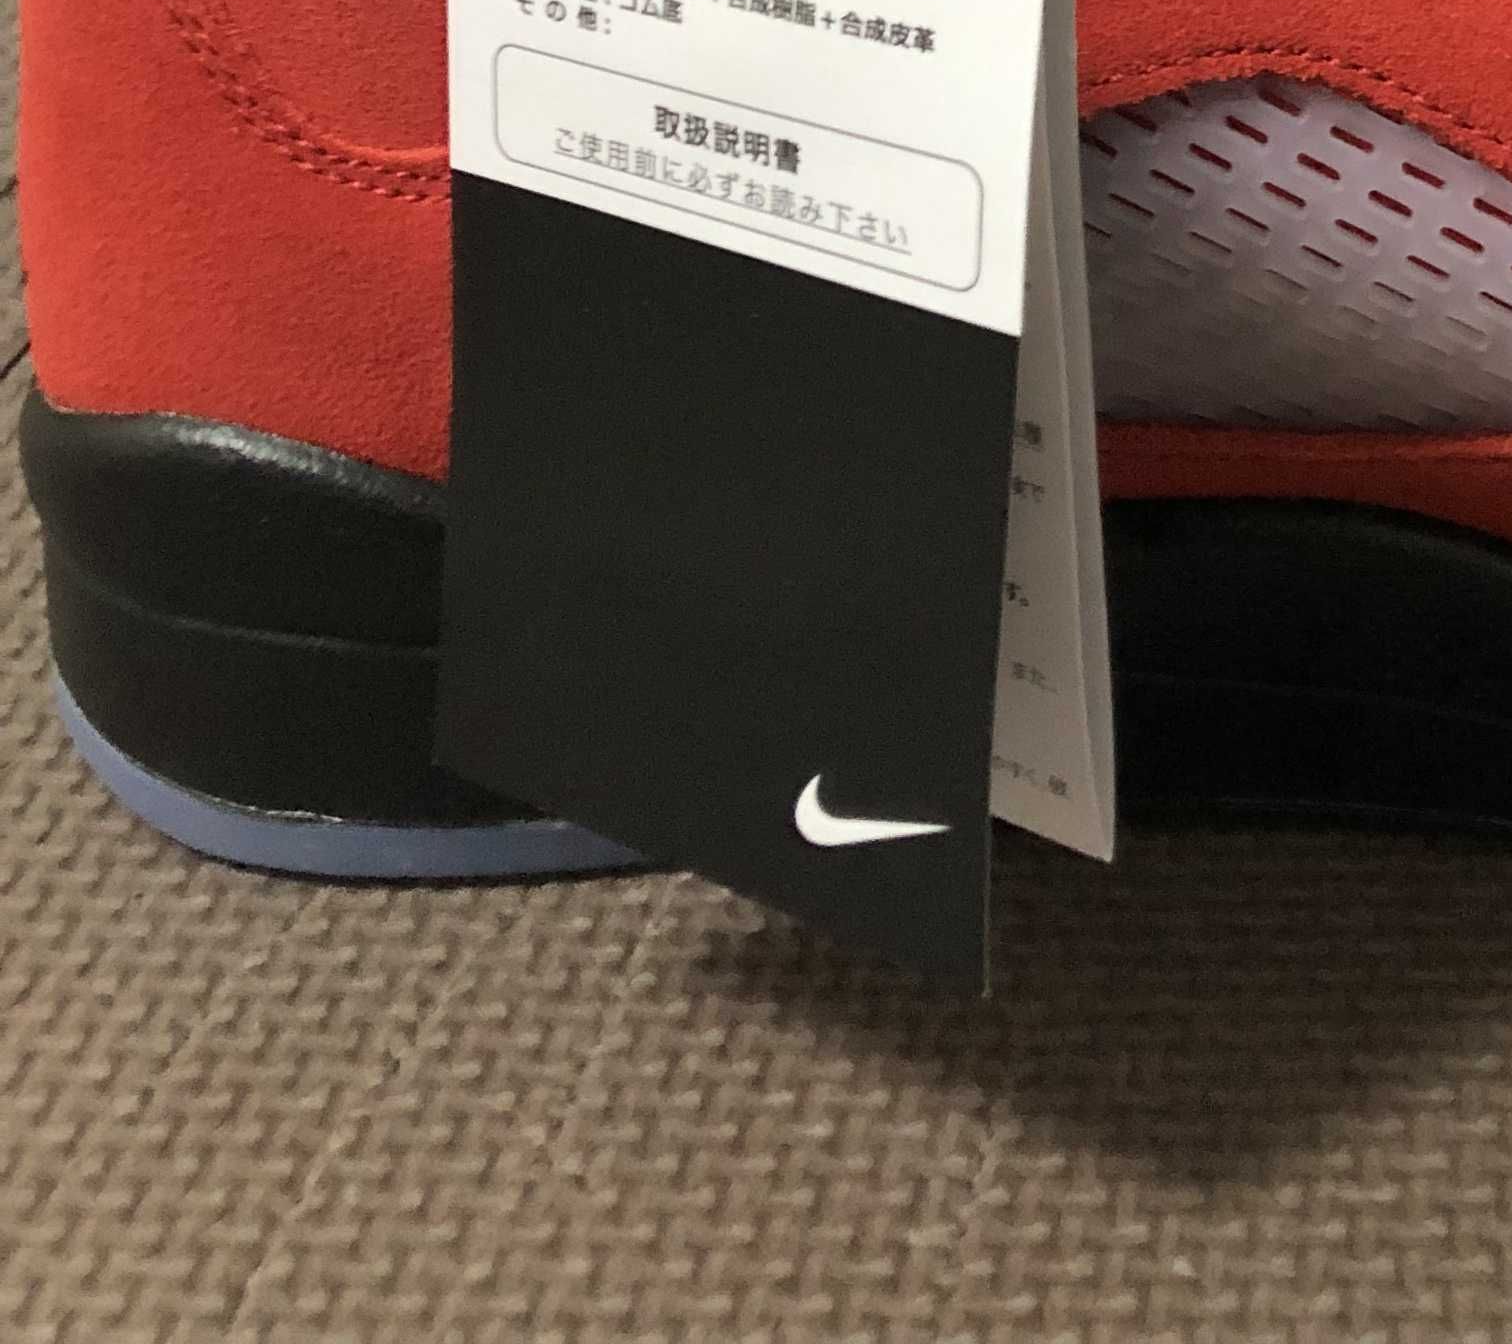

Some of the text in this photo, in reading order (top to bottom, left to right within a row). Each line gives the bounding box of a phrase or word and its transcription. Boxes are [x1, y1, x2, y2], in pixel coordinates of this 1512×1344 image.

[654, 104, 801, 174] 取扱説明書
[555, 128, 910, 246] ご使用前に必ずお読み下さい
